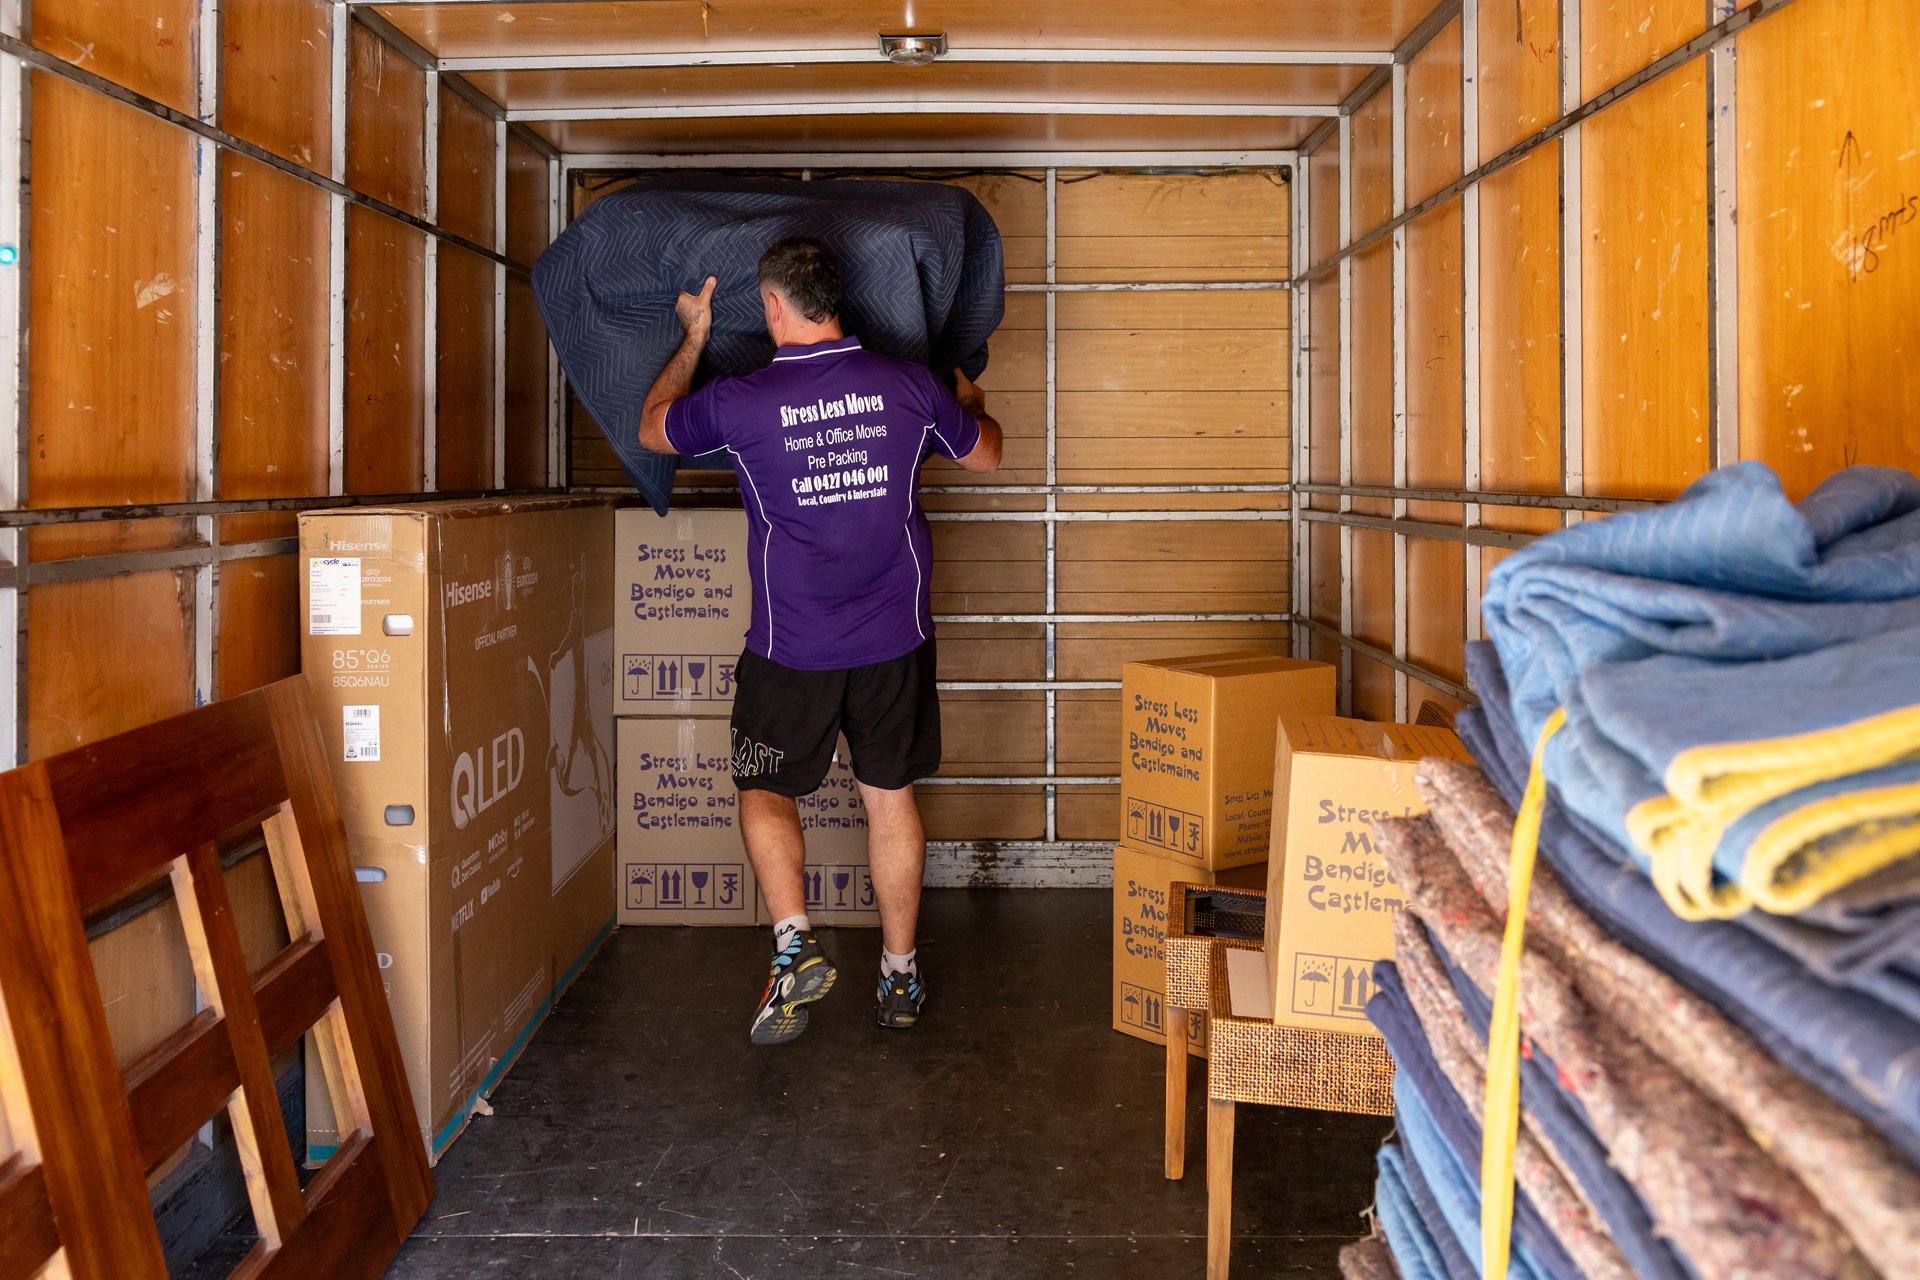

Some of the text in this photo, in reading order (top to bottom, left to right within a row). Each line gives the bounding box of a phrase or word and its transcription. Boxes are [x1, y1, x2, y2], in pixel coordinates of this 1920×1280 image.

[780, 393, 884, 427] Stress Less Moves
[784, 424, 887, 452] Home & Office Moves
[808, 449, 868, 470] Pre Packing
[791, 465, 888, 493] Call 0427 046 001
[798, 486, 887, 506] Local, Country & Interstate
[637, 543, 727, 563] Stress Less
[654, 564, 711, 582] Moves
[445, 579, 492, 608] Hisense
[630, 583, 733, 601] Bendigo and
[634, 602, 729, 621] Castlemaine
[475, 624, 518, 650] OFFICIAL PARTNER
[366, 649, 391, 664] Q6
[333, 676, 390, 688] 85Q6NAU
[1134, 694, 1199, 724] Stress Less
[1145, 716, 1187, 742] Moves
[1129, 731, 1204, 762] Bendigo and
[640, 753, 729, 771] Stress Less
[1131, 752, 1200, 782] Castlemaine
[451, 727, 525, 830] QLED
[656, 773, 713, 791] Moves
[820, 777, 855, 792] oves
[633, 792, 736, 811] Bendigo and
[798, 794, 840, 812] ndigo
[1224, 794, 1244, 806] Stress
[636, 811, 733, 830] Castlemaine
[801, 814, 869, 832] stlemain
[1225, 807, 1272, 822] Local, Countr
[1238, 821, 1263, 832] Phone:
[1128, 880, 1165, 905] Stress
[451, 898, 474, 935] NETFLIX
[777, 923, 797, 938] ILA
